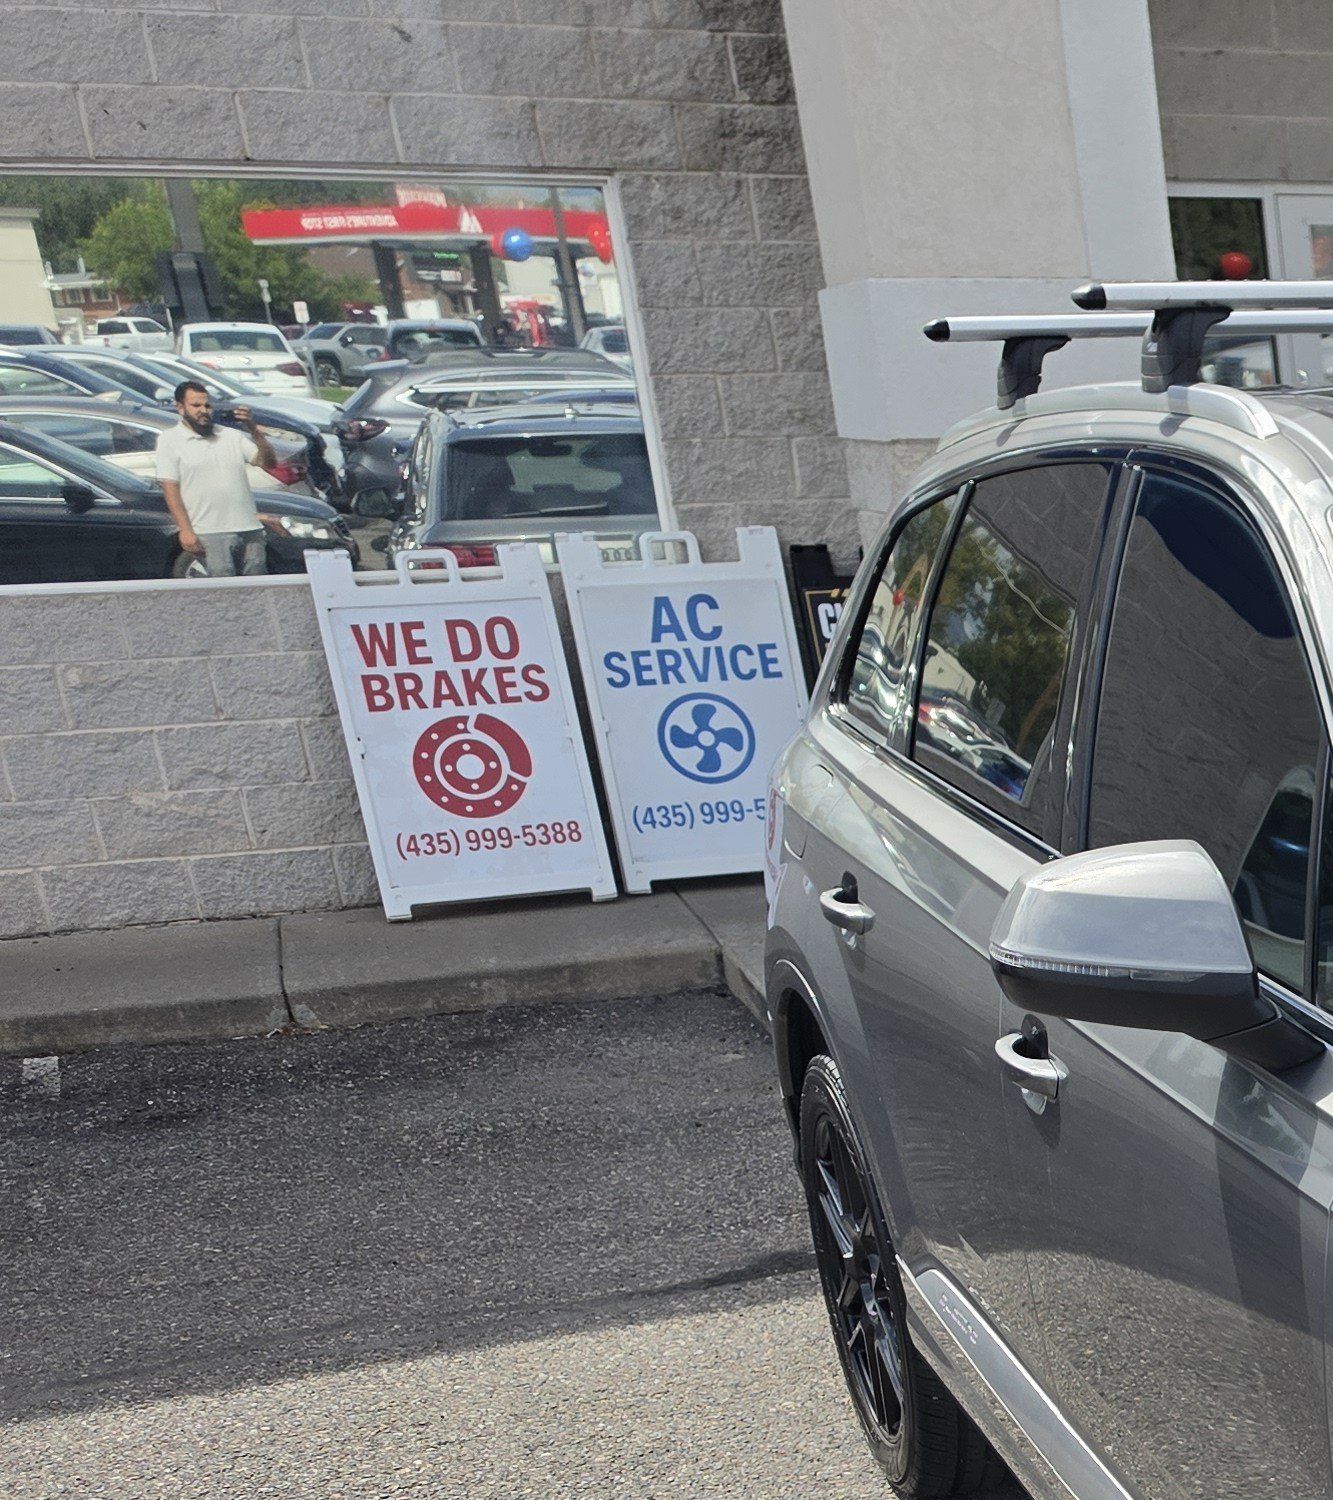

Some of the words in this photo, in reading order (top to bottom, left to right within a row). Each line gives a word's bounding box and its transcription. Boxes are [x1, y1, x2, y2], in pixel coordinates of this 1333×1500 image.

[351, 620, 433, 667] WE
[444, 616, 520, 663] DO
[651, 593, 723, 643] AC
[361, 663, 550, 713] BRAKES
[604, 643, 783, 690] SERVICE
[396, 828, 460, 861] (435)
[466, 821, 582, 853] 999-5388
[633, 800, 695, 834] (435)
